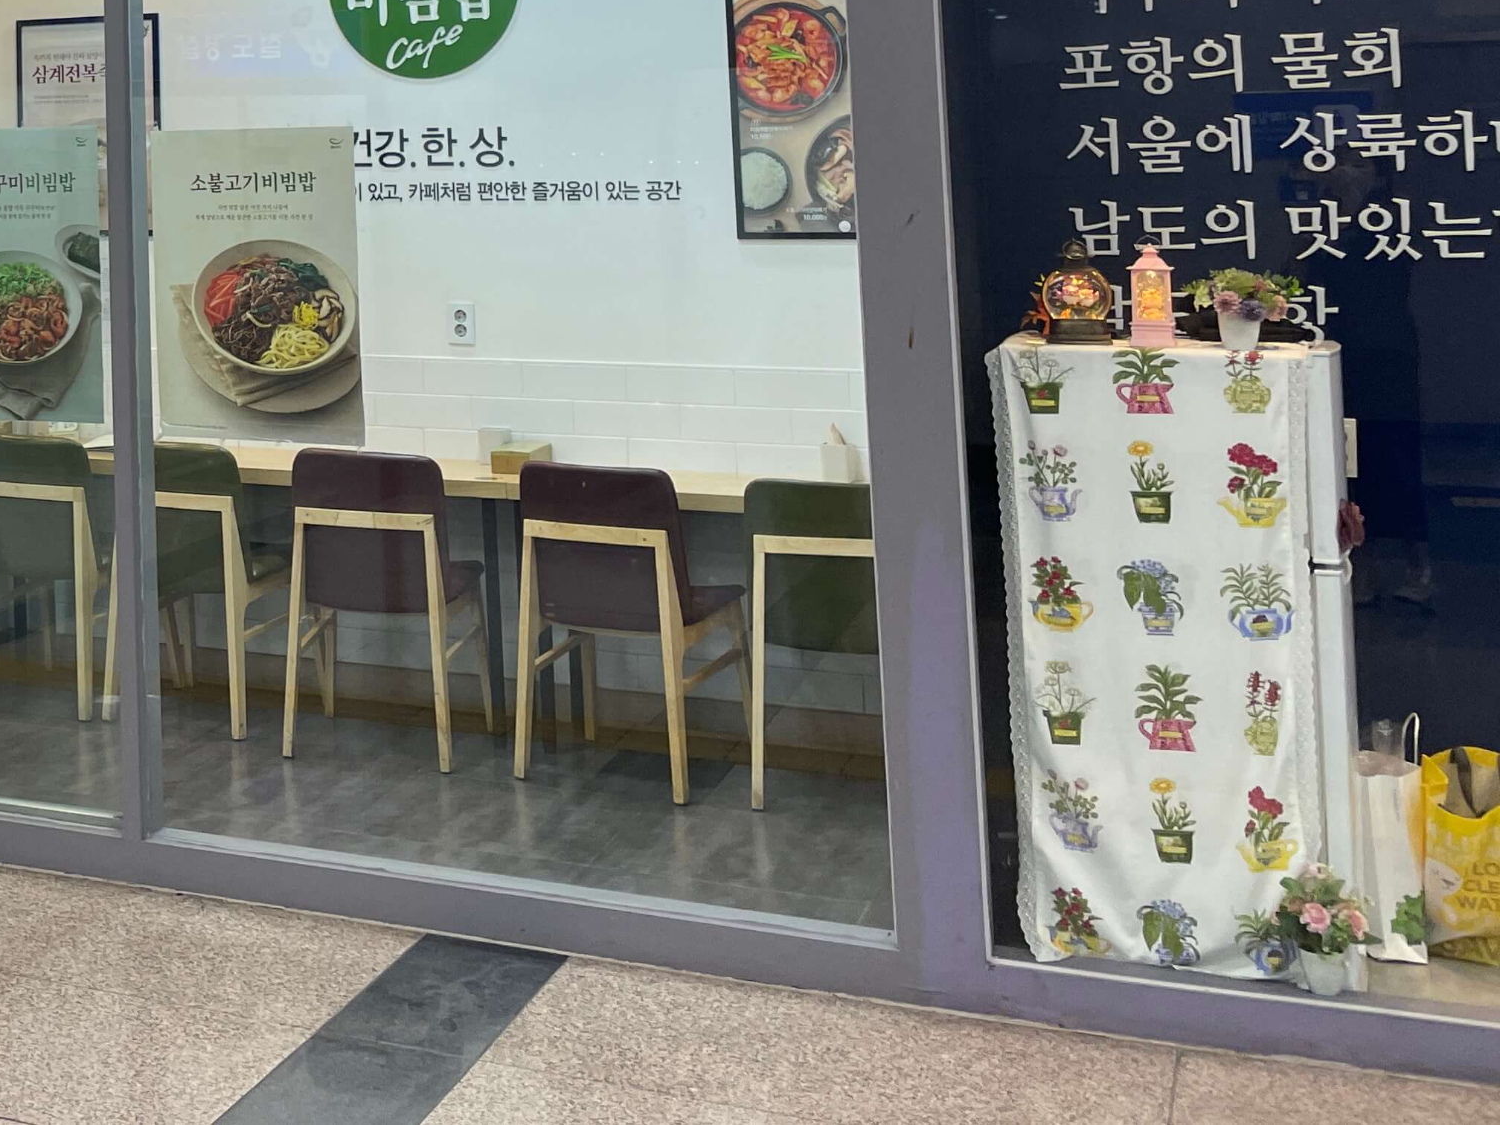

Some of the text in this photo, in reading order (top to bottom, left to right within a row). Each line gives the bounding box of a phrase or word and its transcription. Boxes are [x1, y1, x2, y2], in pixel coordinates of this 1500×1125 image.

[1059, 27, 1402, 95] 포항의 물회
[1066, 114, 1253, 175] 서울에
[190, 171, 317, 193] 소불고기비빔밥
[368, 182, 402, 203] 있고,
[408, 182, 471, 203] 카페처럼
[477, 181, 527, 202] 편안한
[532, 181, 599, 202] 즐거움이
[605, 181, 640, 201] 있는
[645, 180, 681, 201] 공간
[1068, 198, 1492, 261] 남도의 맛있는
